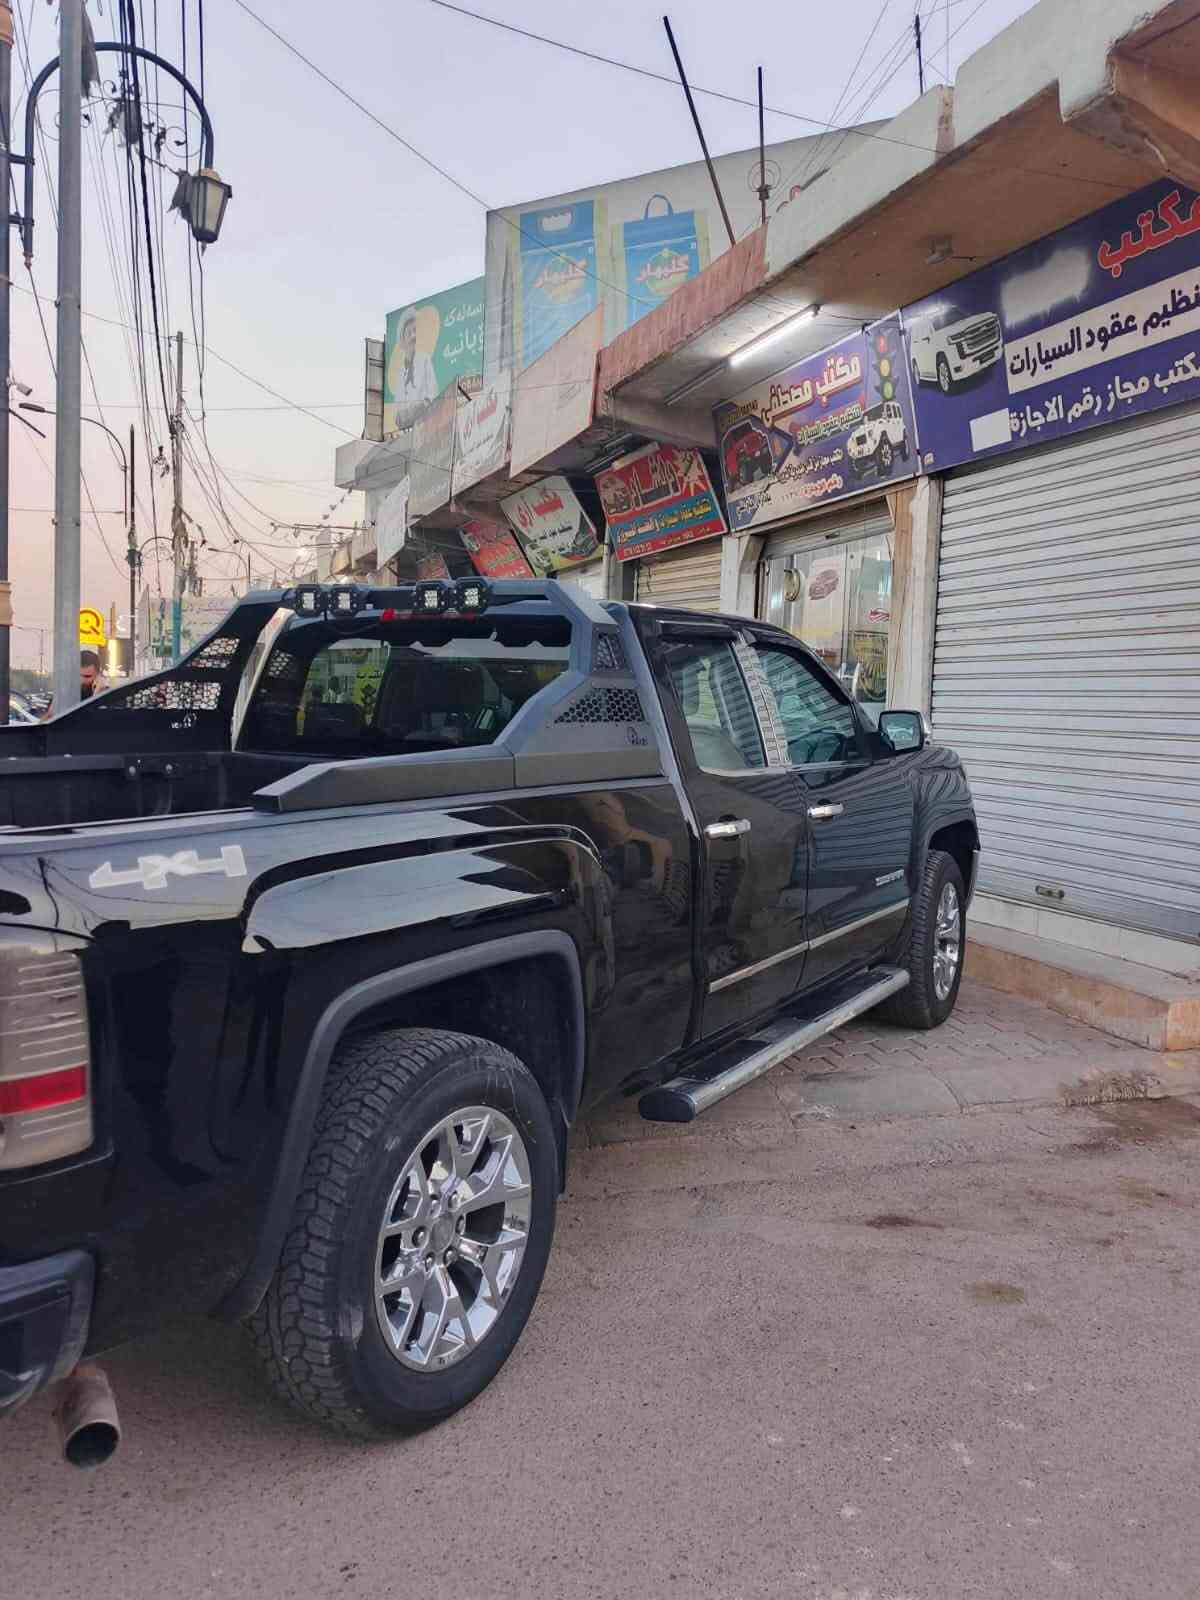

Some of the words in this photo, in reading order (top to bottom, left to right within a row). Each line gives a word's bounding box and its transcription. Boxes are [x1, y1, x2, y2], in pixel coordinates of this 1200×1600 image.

[1009, 327, 1082, 377] السيارات
[1084, 312, 1138, 352] عقود
[815, 354, 862, 406] مكتب
[1106, 374, 1150, 412] مجاز
[1066, 387, 1102, 423] رقم
